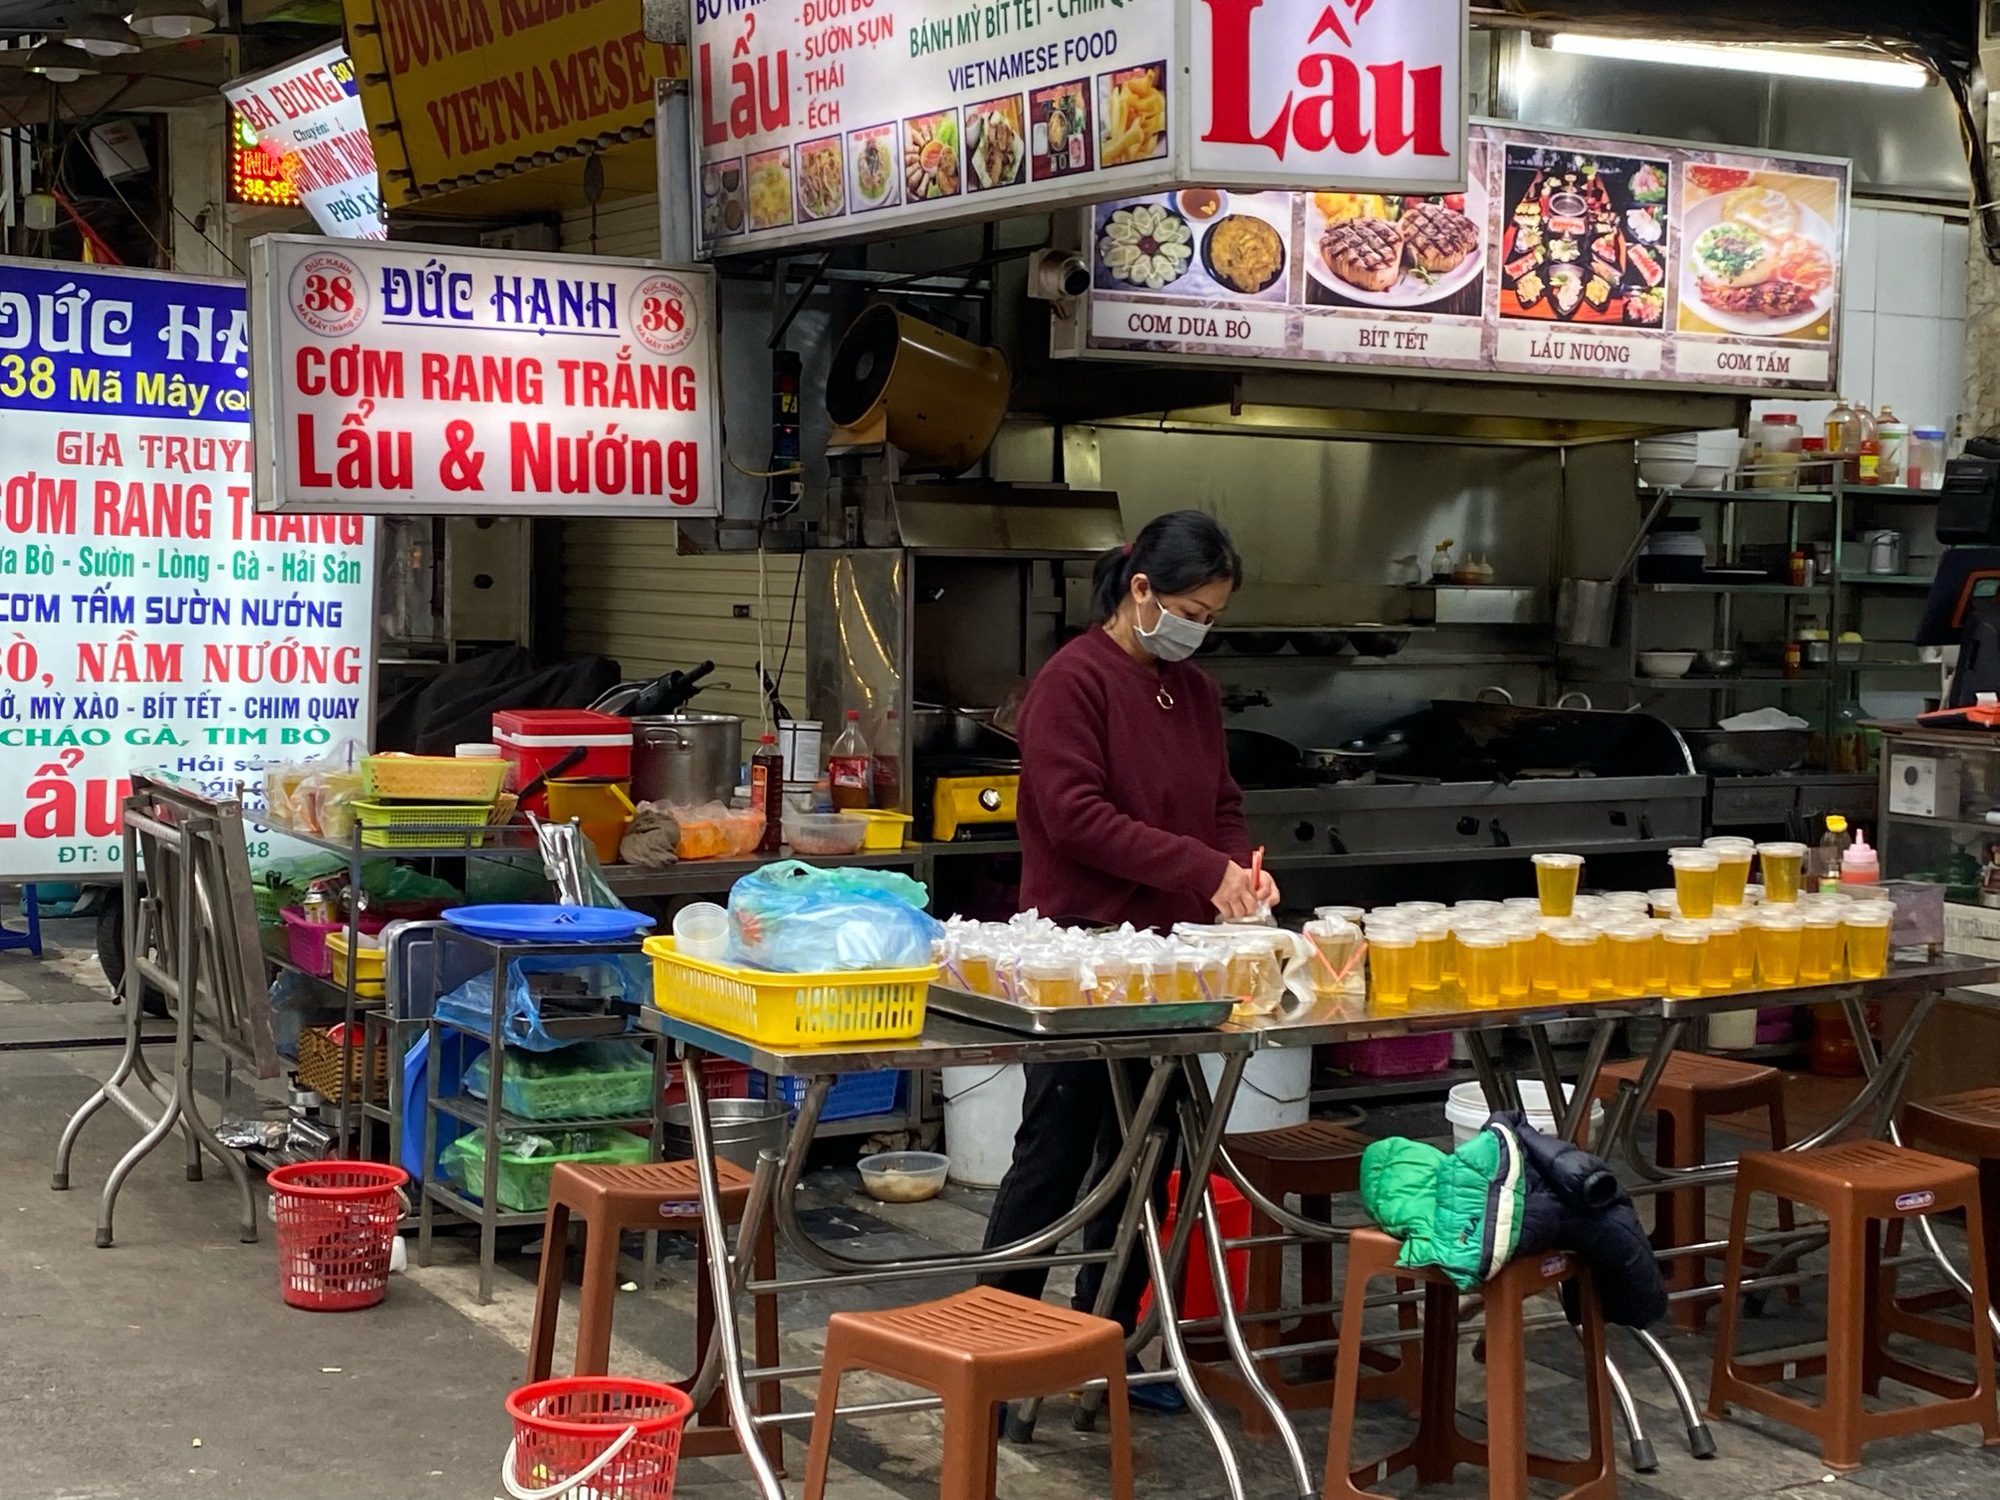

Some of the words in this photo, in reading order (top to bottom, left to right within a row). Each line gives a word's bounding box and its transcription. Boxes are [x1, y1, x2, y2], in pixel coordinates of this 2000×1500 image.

[804, 25, 852, 61] SƯỜN
[858, 14, 894, 50] SỤN
[910, 18, 952, 58] BÁNH
[958, 4, 980, 46] MỲ
[700, 12, 790, 147] Lẩu
[805, 60, 844, 94] THÁI
[948, 44, 1058, 92] VIETNAMESE
[1065, 29, 1118, 66] FOOD
[236, 88, 282, 132] BÀ
[426, 30, 655, 159] VIETNAMESE
[808, 98, 840, 130] ẾCH
[305, 274, 354, 312] 38
[380, 259, 473, 320] ĐỨC
[490, 275, 618, 336] HẠNH
[642, 297, 684, 332] 38
[0, 282, 132, 357] ĐỨC
[1128, 314, 1172, 334] COM
[1178, 317, 1220, 338] DUA
[1225, 316, 1251, 339] BÒ
[1359, 325, 1390, 348] BÍT
[1394, 326, 1428, 350] TẾT
[0, 354, 56, 399] 38
[70, 368, 122, 404] Mã
[136, 372, 210, 416] Mây
[296, 343, 404, 399] CƠM
[422, 352, 544, 404] RANG
[557, 345, 696, 412] TRẮNG
[57, 430, 124, 468] GIA
[298, 398, 414, 490] Lẩu
[439, 419, 486, 492] &
[510, 422, 699, 506] Nướng
[0, 471, 77, 536] ƠM
[94, 479, 212, 540] RANG
[26, 544, 54, 575] Bò
[78, 546, 134, 578] Sườn
[158, 549, 210, 582] Lòng
[232, 551, 260, 582] Gà
[282, 550, 315, 583] Hải
[323, 551, 362, 584] Sản
[72, 582, 134, 624] TẤM
[146, 588, 230, 626] SƯỜN
[242, 592, 342, 628] NƯỚNG
[0, 632, 54, 688] Ò,
[76, 629, 184, 684] NẦM
[202, 636, 363, 685] NƯỚNG
[30, 690, 66, 720] MỲ
[74, 692, 118, 720] XÀO
[143, 692, 177, 720] BÍT
[185, 690, 222, 720] TẾT
[244, 698, 300, 720] CHIM
[308, 698, 360, 722] QUAY
[0, 724, 110, 746] CHÁO
[124, 724, 190, 748] GÀ,
[202, 727, 268, 745] TIM
[280, 724, 330, 745] BÒ
[178, 754, 224, 772] Hải
[58, 846, 97, 863] ĐT:
